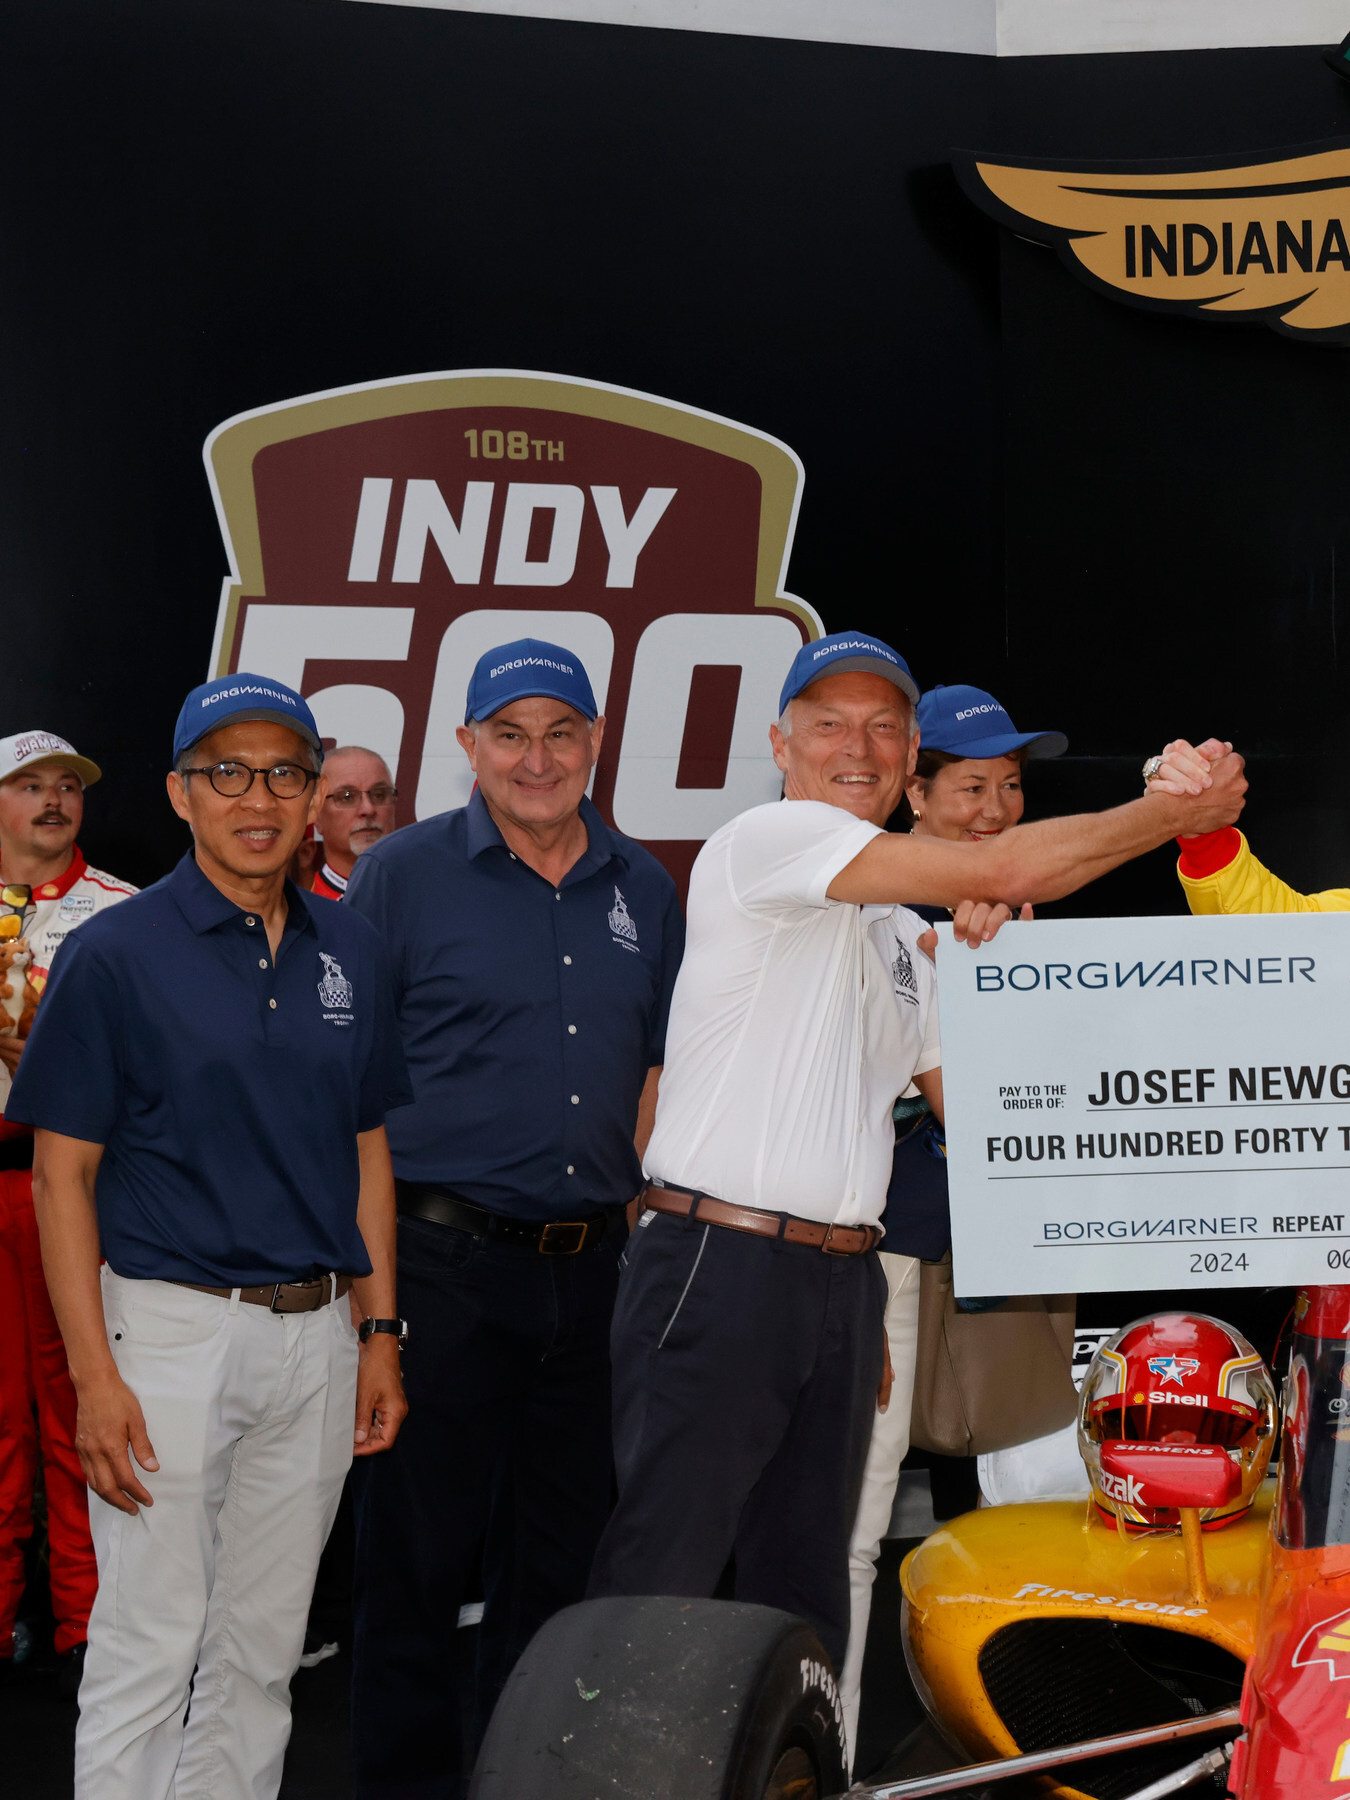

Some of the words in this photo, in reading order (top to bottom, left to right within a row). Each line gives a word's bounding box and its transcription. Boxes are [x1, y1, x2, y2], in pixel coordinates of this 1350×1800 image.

[464, 429, 565, 462] 108TH
[347, 477, 678, 589] INDY
[490, 656, 574, 679] BORGWARNER
[201, 685, 297, 708] BORGWARNER
[975, 956, 1317, 992] BORGWARNER
[999, 1086, 1022, 1098] PAY
[1025, 1085, 1041, 1097] TO
[1044, 1084, 1067, 1096] THE
[1088, 1068, 1215, 1106] JOSEF
[1003, 1098, 1043, 1110] ORDER
[1046, 1097, 1065, 1109] OF:
[987, 1135, 1066, 1162] FOUR
[1076, 1130, 1224, 1159] HUNDRED
[1235, 1127, 1329, 1155] FORTY
[1043, 1216, 1258, 1240] BORGWARNER
[1272, 1215, 1345, 1233] REPEAT
[1189, 1252, 1250, 1273] 2024
[1148, 1391, 1209, 1408] Shell
[1113, 1444, 1214, 1455] SIEMENS
[1012, 1582, 1209, 1617] Firestone
